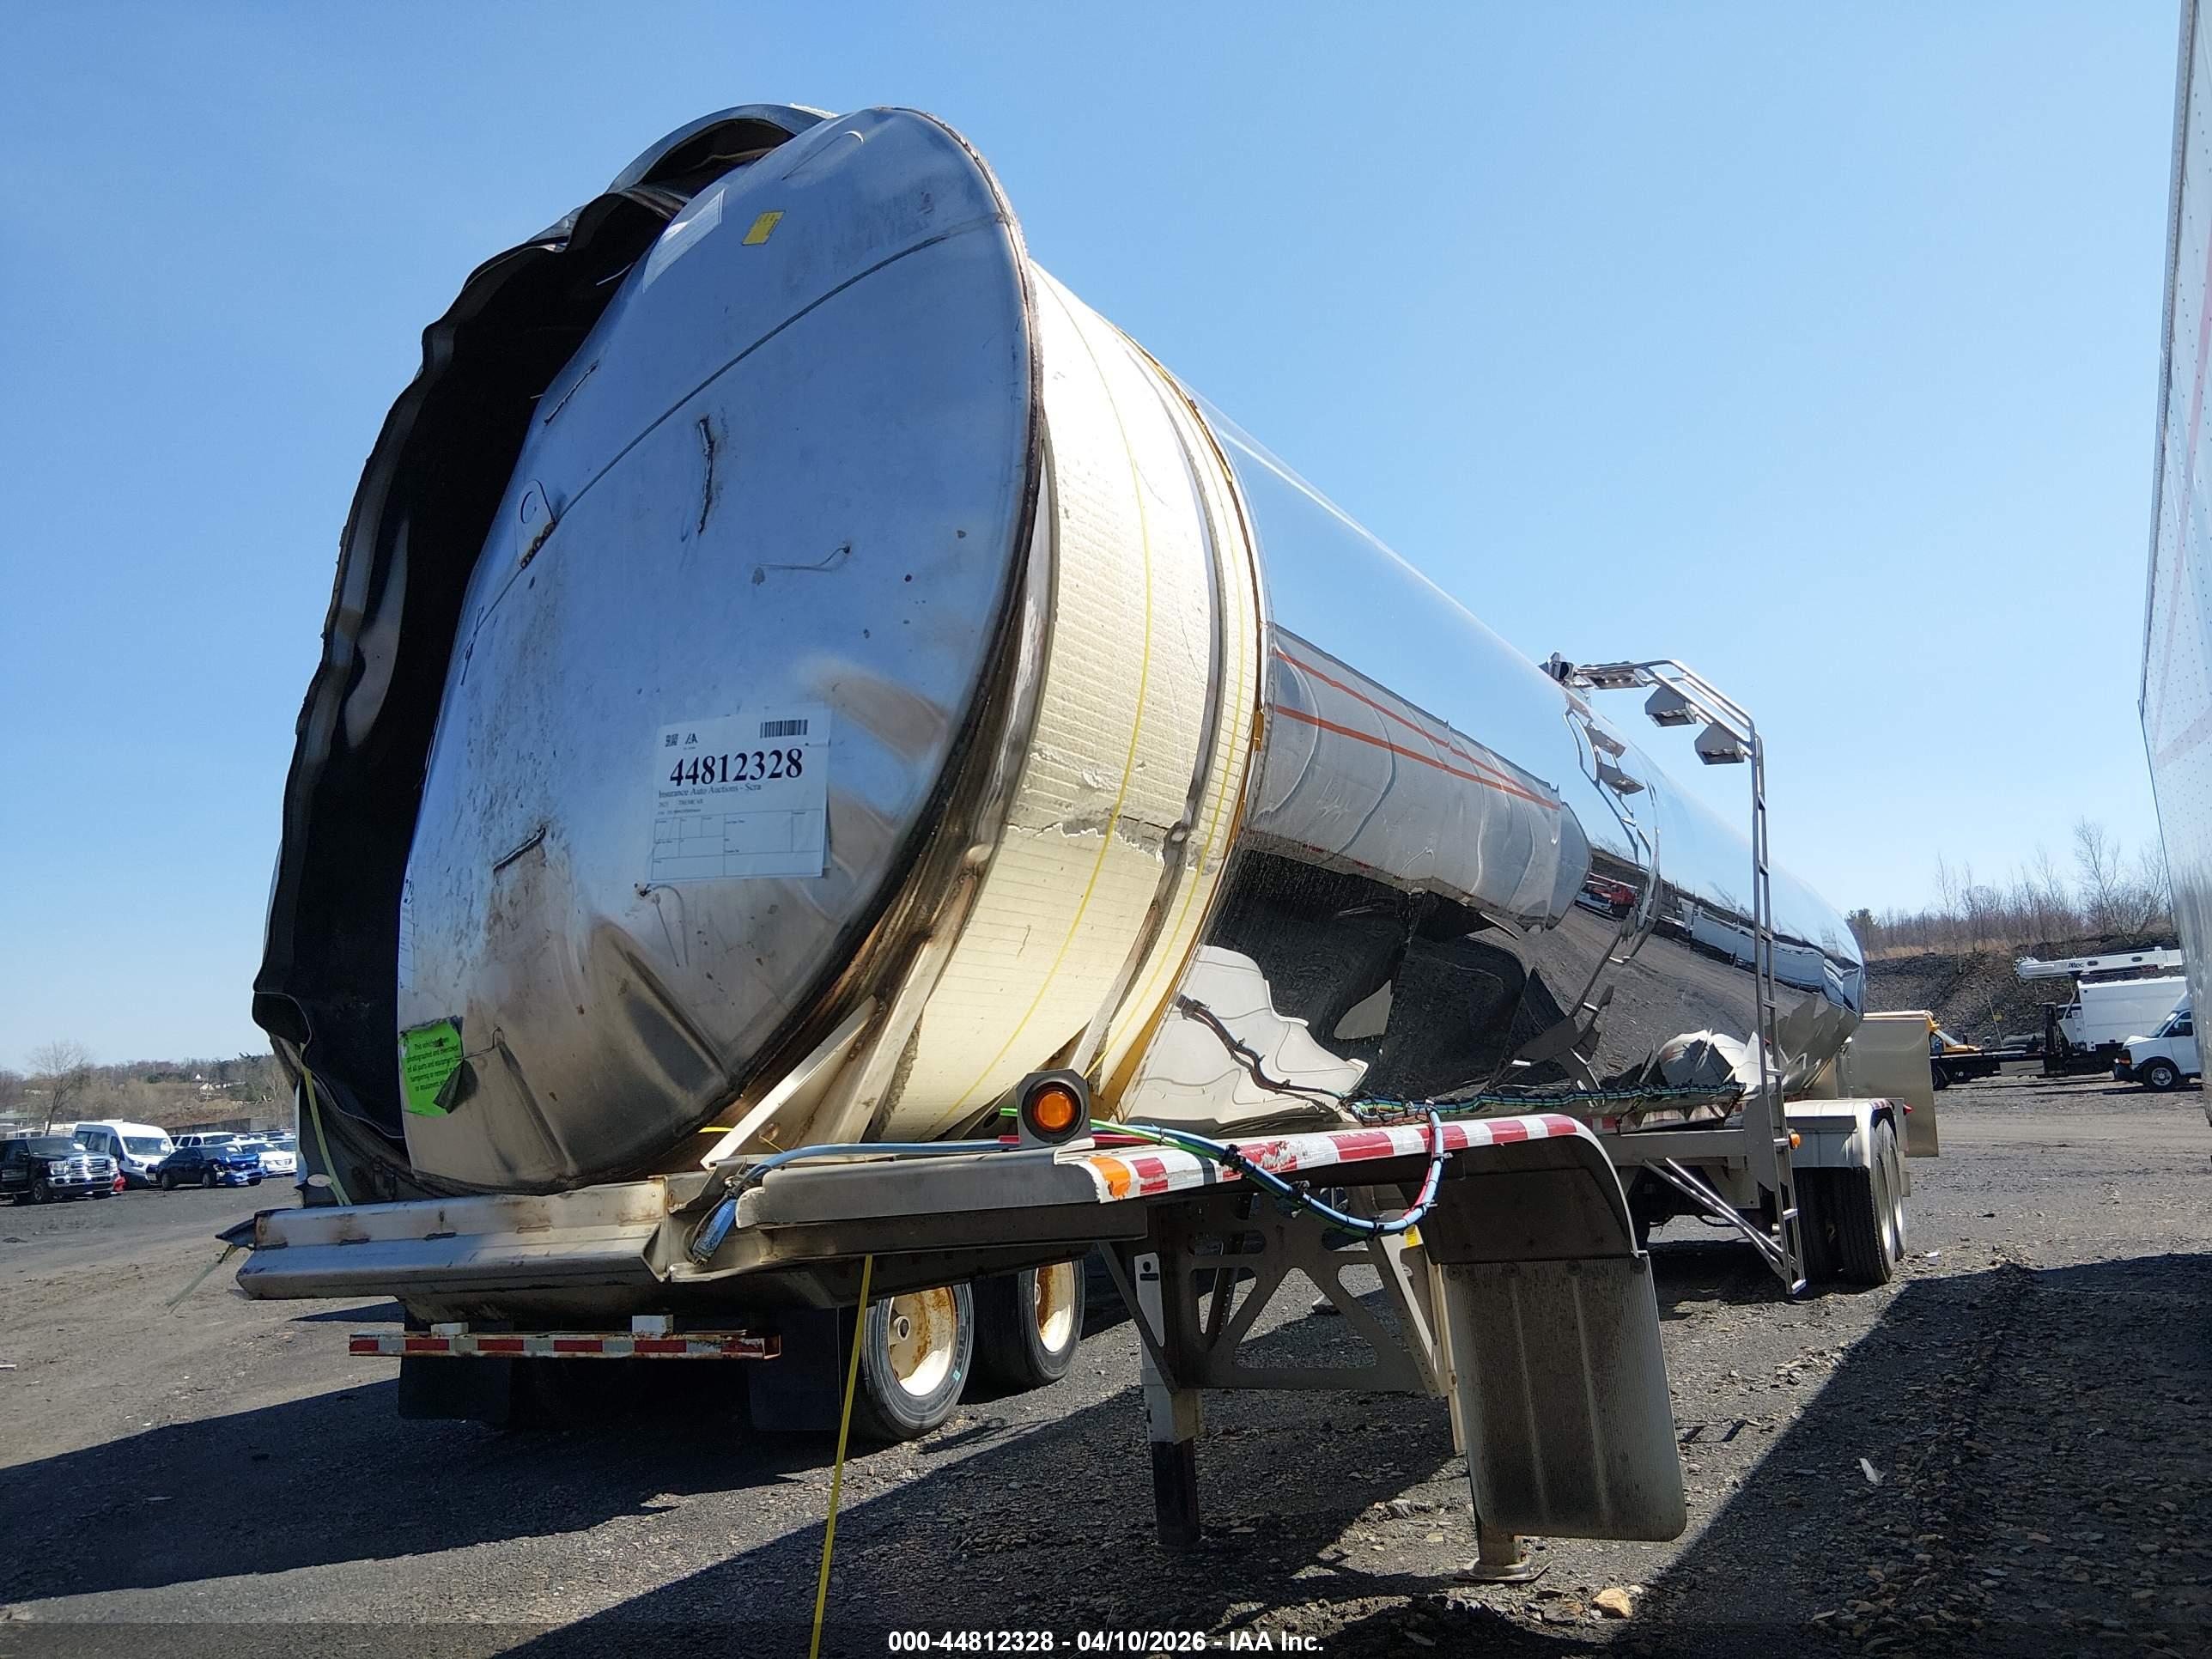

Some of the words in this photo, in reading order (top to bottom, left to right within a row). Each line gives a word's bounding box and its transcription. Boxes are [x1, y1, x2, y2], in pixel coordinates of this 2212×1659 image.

[670, 748, 803, 787] 44812328
[659, 790, 689, 799] Insurance
[708, 786, 738, 794] Auctions
